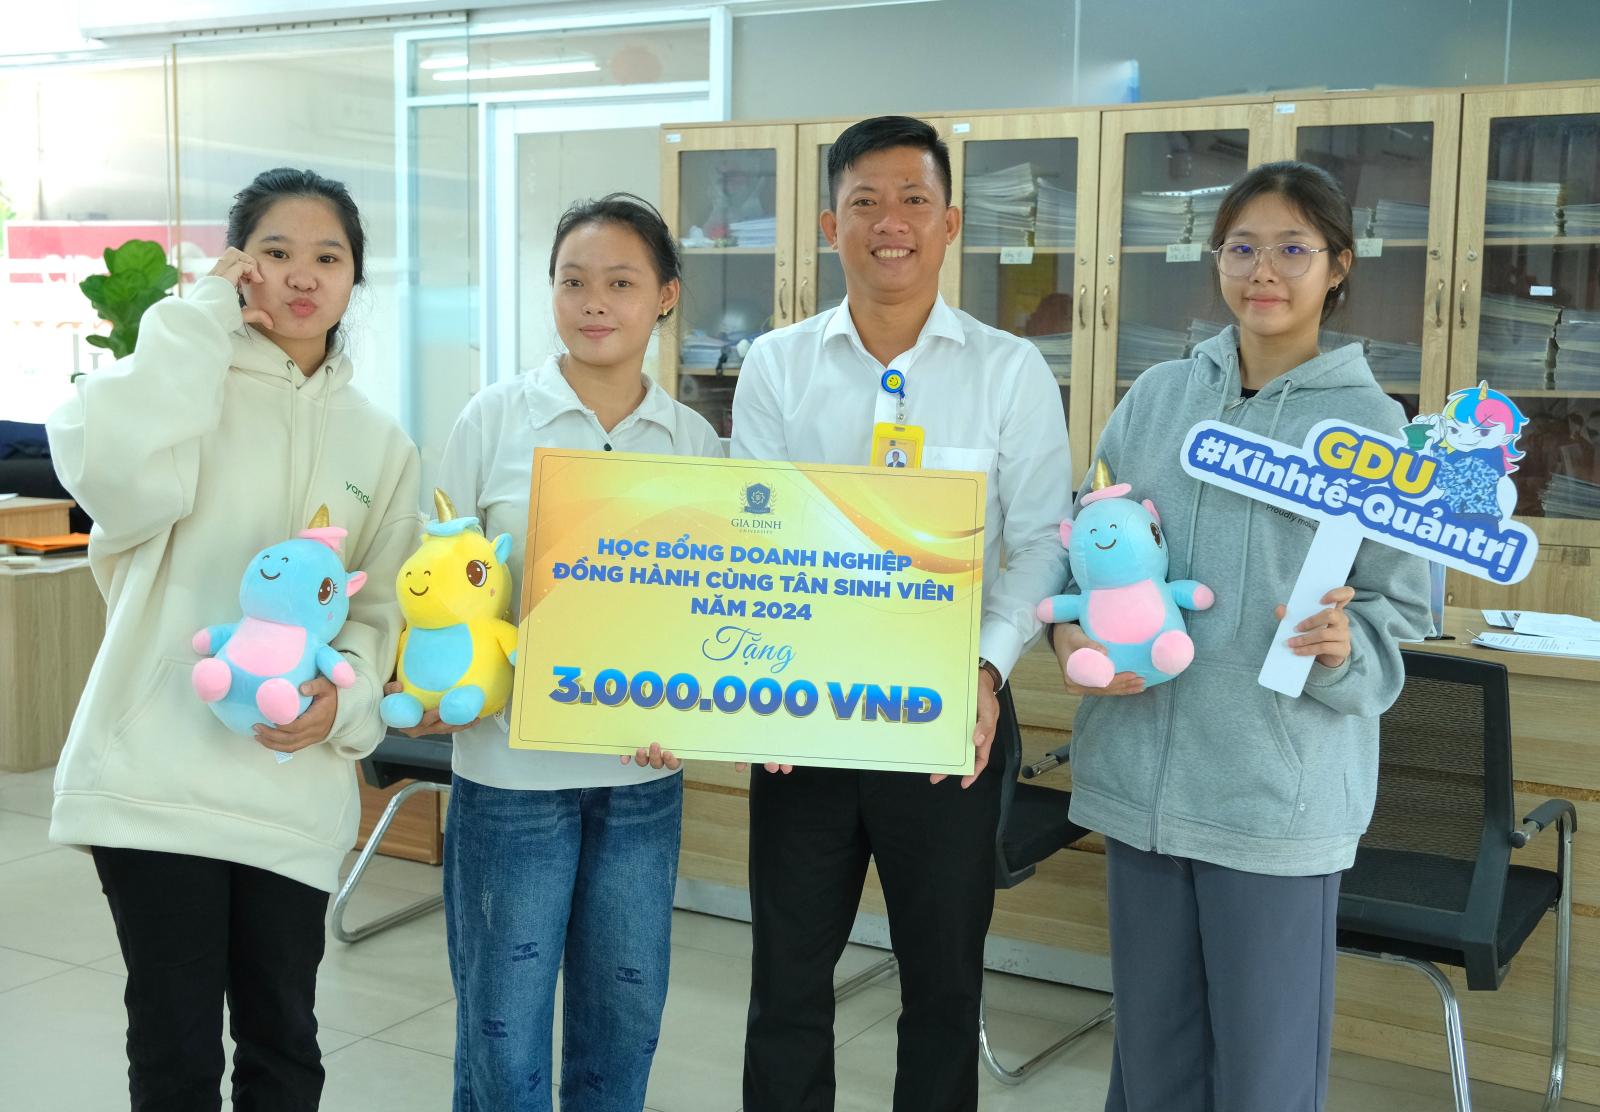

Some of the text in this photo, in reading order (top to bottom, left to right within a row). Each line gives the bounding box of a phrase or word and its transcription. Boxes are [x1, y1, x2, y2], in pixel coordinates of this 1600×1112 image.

[1318, 431, 1436, 495] GDU
[731, 518, 782, 530] GIA DINH
[1266, 503, 1297, 522] Proudly
[597, 534, 912, 575] HỌC BỔNG DOANH NGHIỆP
[552, 556, 954, 602] ĐỒNG HÀNH CÙNG TÂN SINH VIÊN
[690, 594, 813, 621] NĂM 2024
[702, 626, 797, 674] Tặng
[548, 665, 943, 724] 3.000.000 VNĐ
